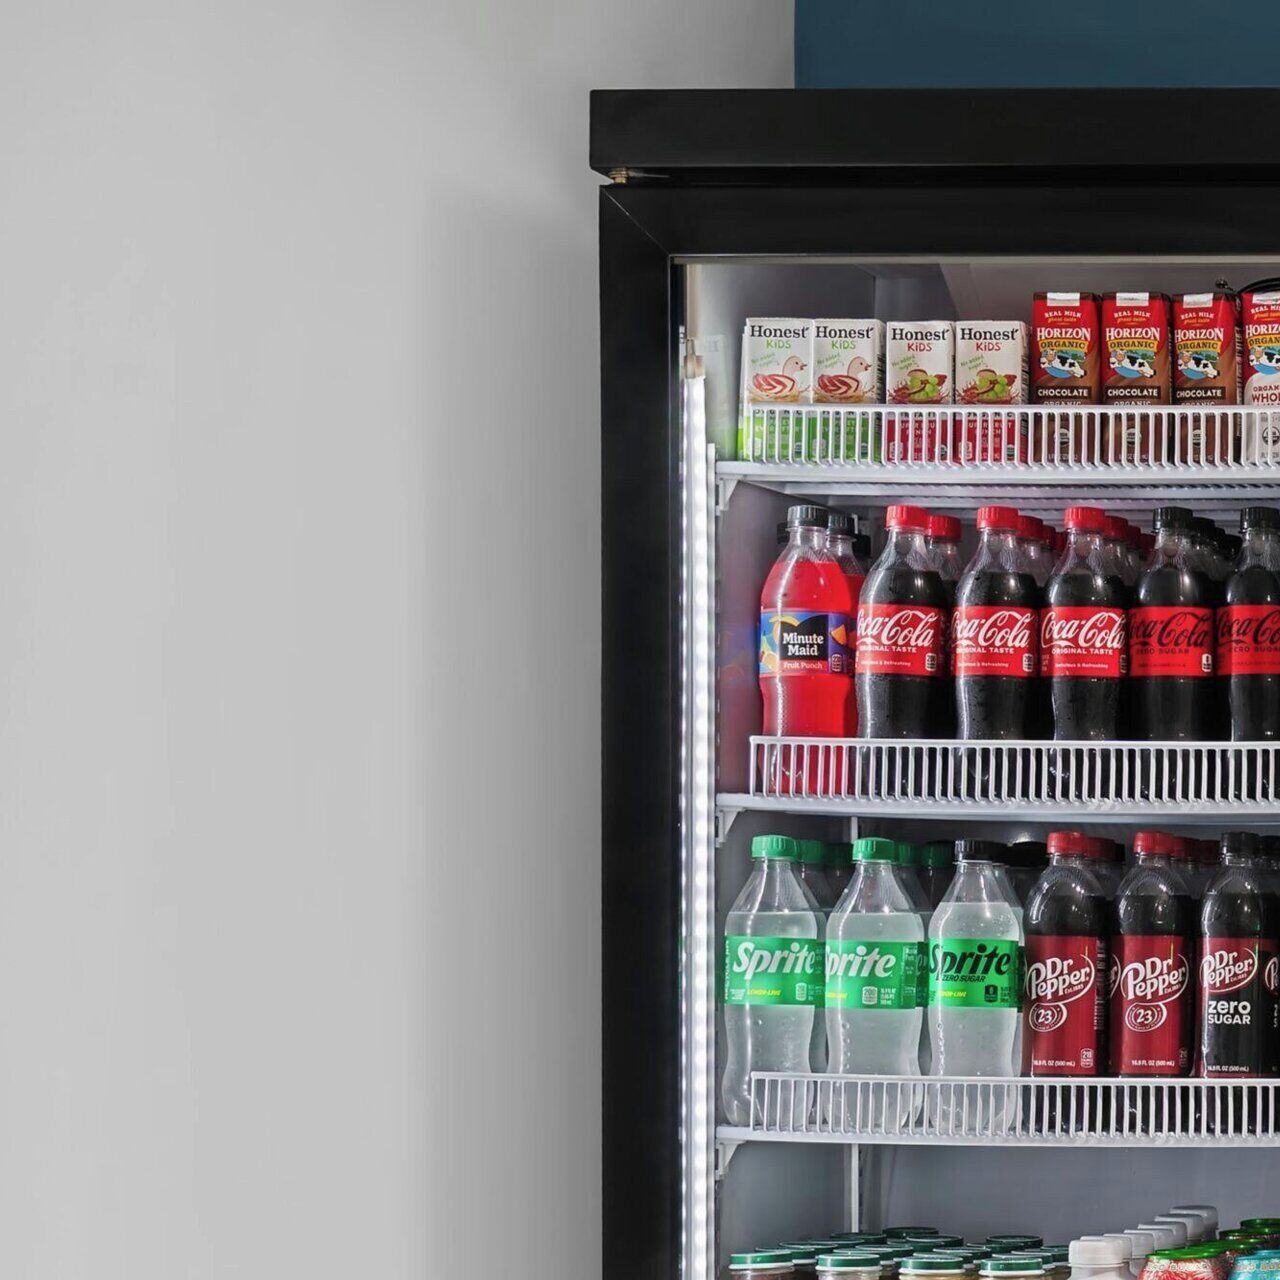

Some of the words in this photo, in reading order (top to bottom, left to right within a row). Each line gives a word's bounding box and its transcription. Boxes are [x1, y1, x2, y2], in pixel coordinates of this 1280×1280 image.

[750, 325, 810, 339] Honest
[815, 325, 874, 340] Honest
[1037, 327, 1091, 342] HORIZON
[1106, 327, 1160, 342] HORIZON
[1040, 341, 1086, 350] ORGANIC
[1109, 341, 1155, 350] ORGANIC
[1038, 388, 1089, 398] CHOCOLATE
[1107, 388, 1158, 397] CHOCOLATE
[782, 632, 824, 645] Minute
[787, 644, 818, 656] Maid
[733, 941, 816, 981] Sprite
[929, 943, 1010, 982] Sprite
[1046, 953, 1073, 980] Dr
[1144, 953, 1171, 979] Dr
[1030, 963, 1089, 998] Pepper
[1122, 964, 1186, 999] Pepper
[1208, 1000, 1251, 1015] zero
[1208, 1013, 1251, 1025] SUGAR
